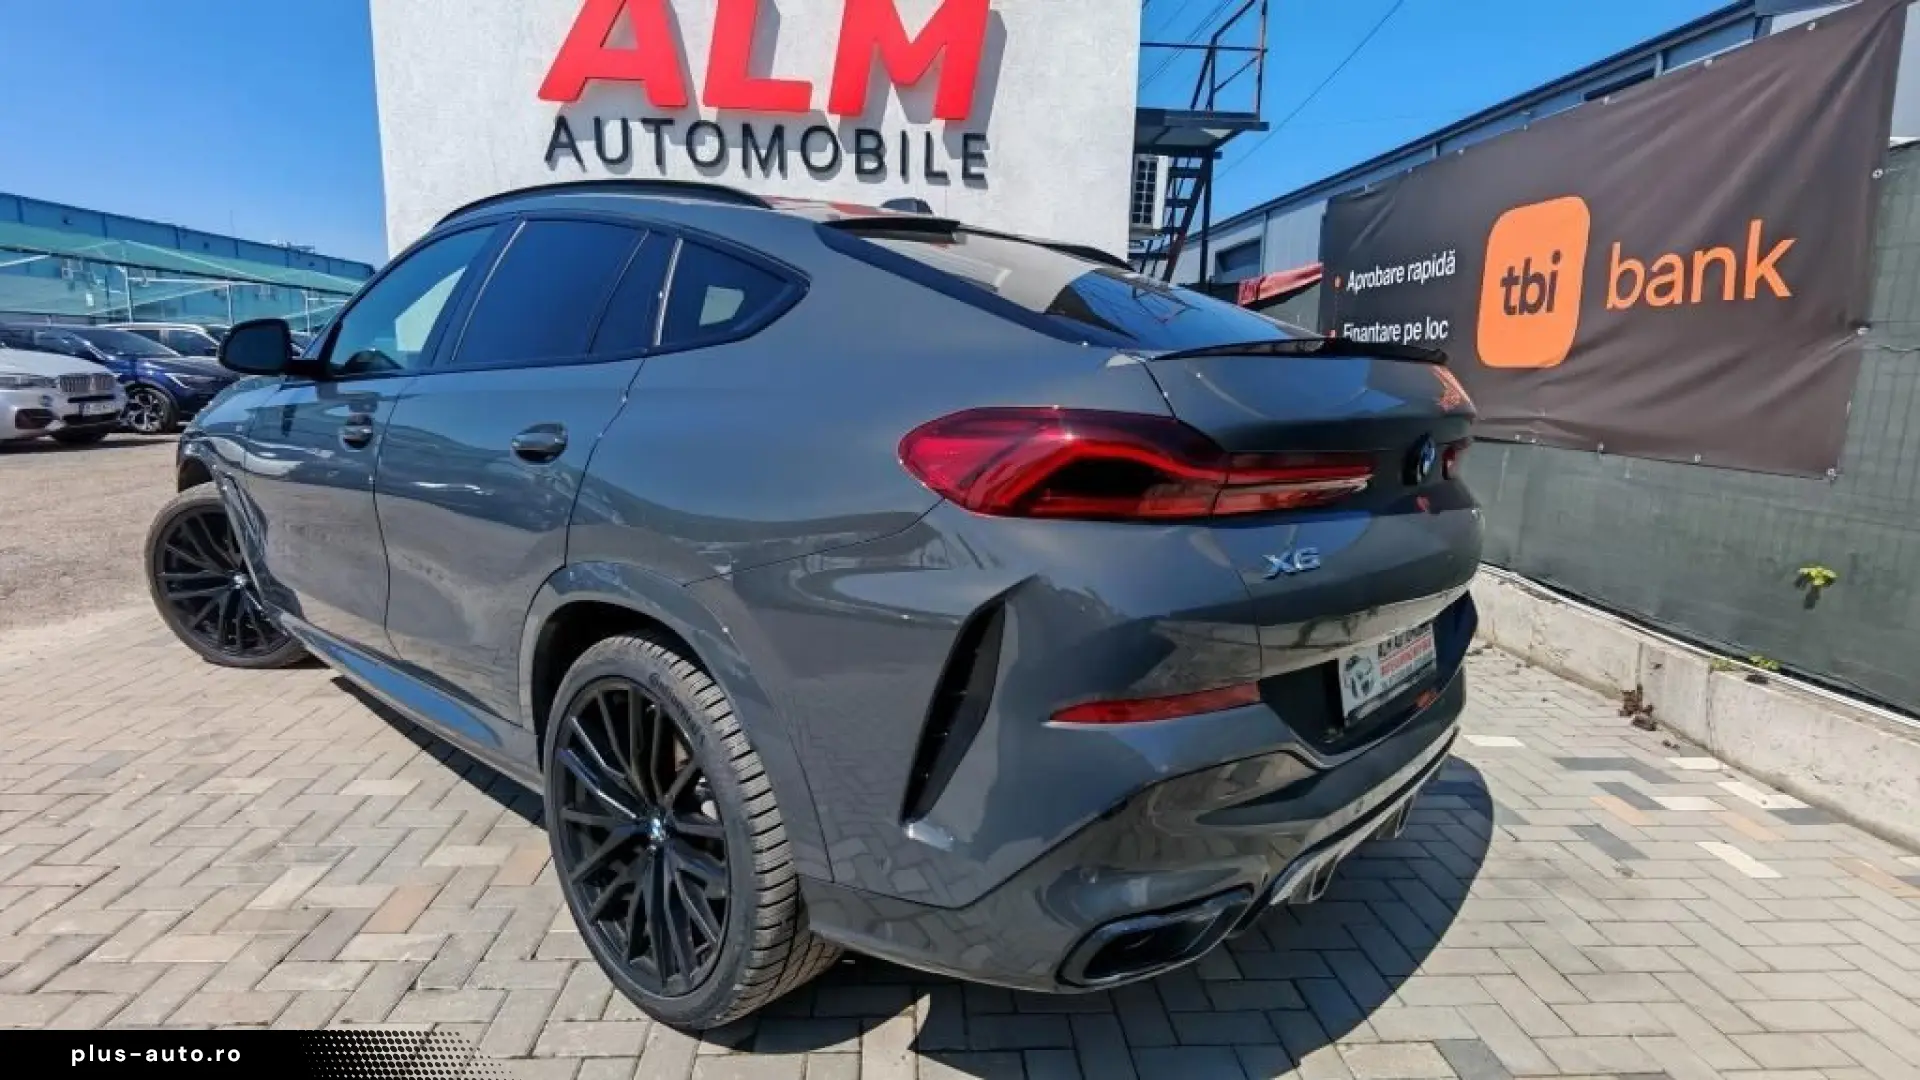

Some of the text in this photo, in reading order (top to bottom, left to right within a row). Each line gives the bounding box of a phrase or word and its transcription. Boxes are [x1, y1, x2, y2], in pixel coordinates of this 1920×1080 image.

[537, 0, 990, 120] ALM
[544, 115, 988, 182] AUTOMOBILE
[1346, 249, 1456, 295] Aprobare rapidă
[1500, 218, 1797, 316] tbi bank
[1403, 321, 1422, 346] pe
[1424, 316, 1449, 340] loc
[1261, 546, 1321, 580] X6
